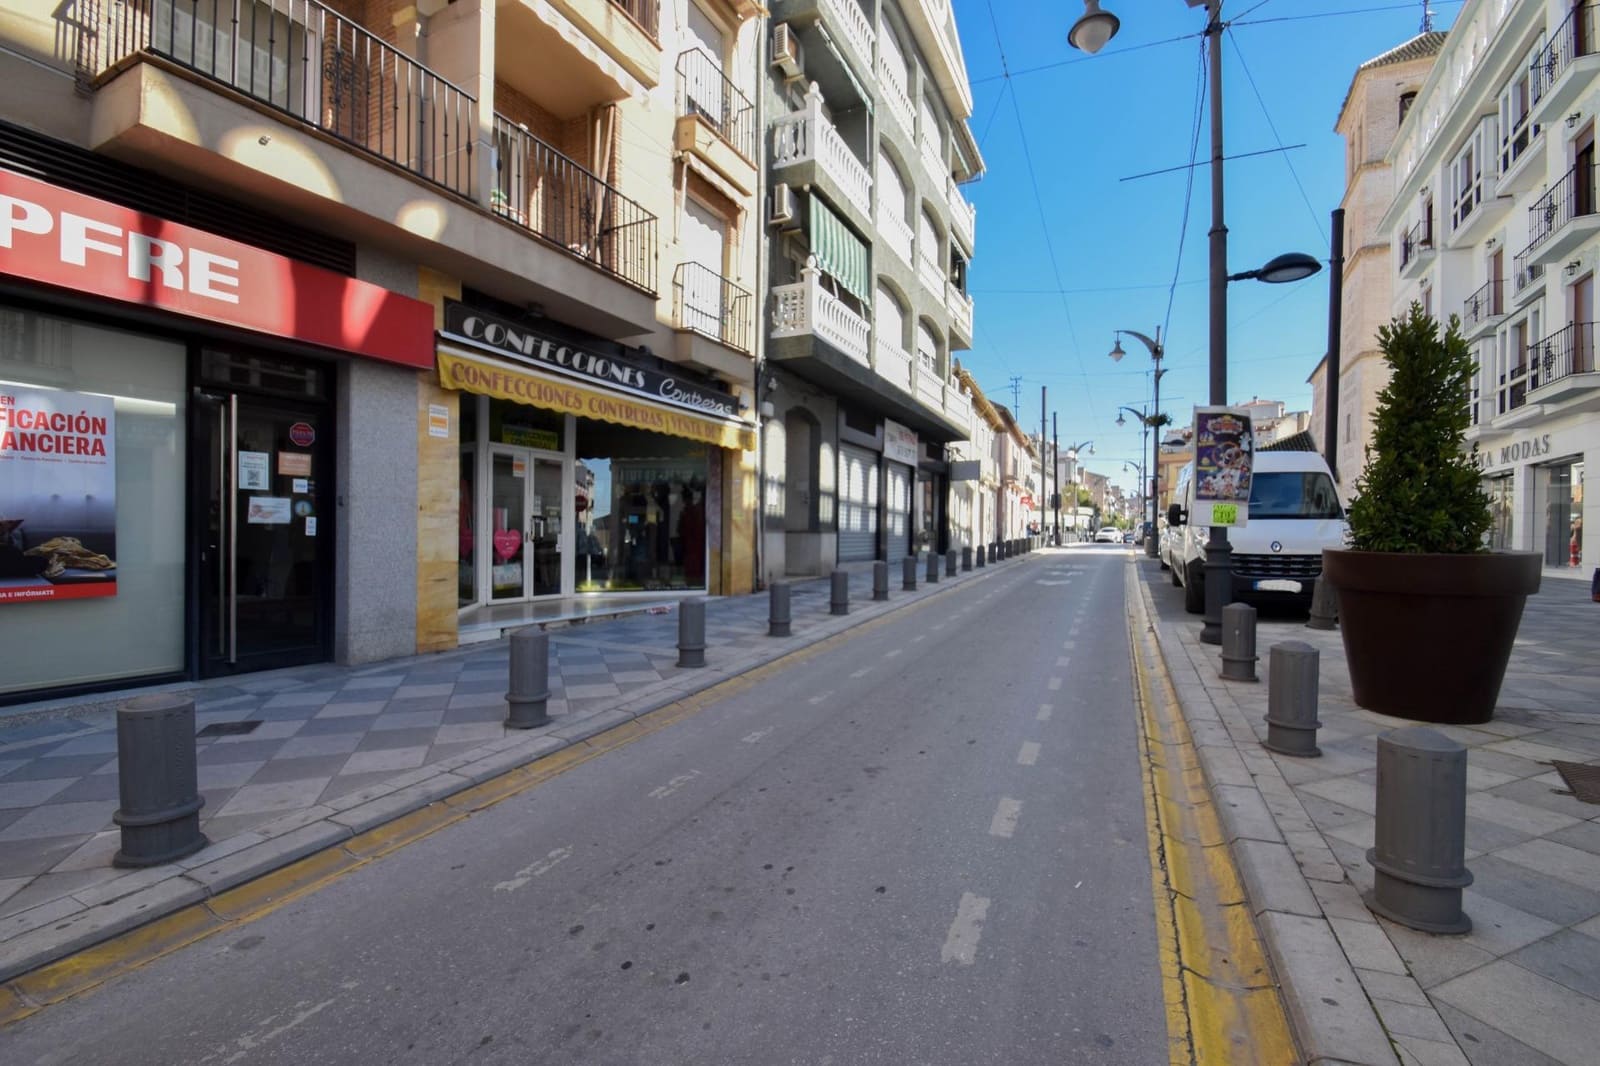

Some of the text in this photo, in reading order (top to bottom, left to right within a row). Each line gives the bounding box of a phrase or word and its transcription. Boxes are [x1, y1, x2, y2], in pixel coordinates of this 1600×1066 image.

[0, 193, 239, 304] PFRE
[452, 362, 583, 409] CONFECCIONES
[588, 397, 663, 427] CONTRERAS
[463, 317, 732, 414] CONFECCIONES Contreras
[2, 431, 106, 456] ANCIERA
[1501, 434, 1550, 464] MODAS
